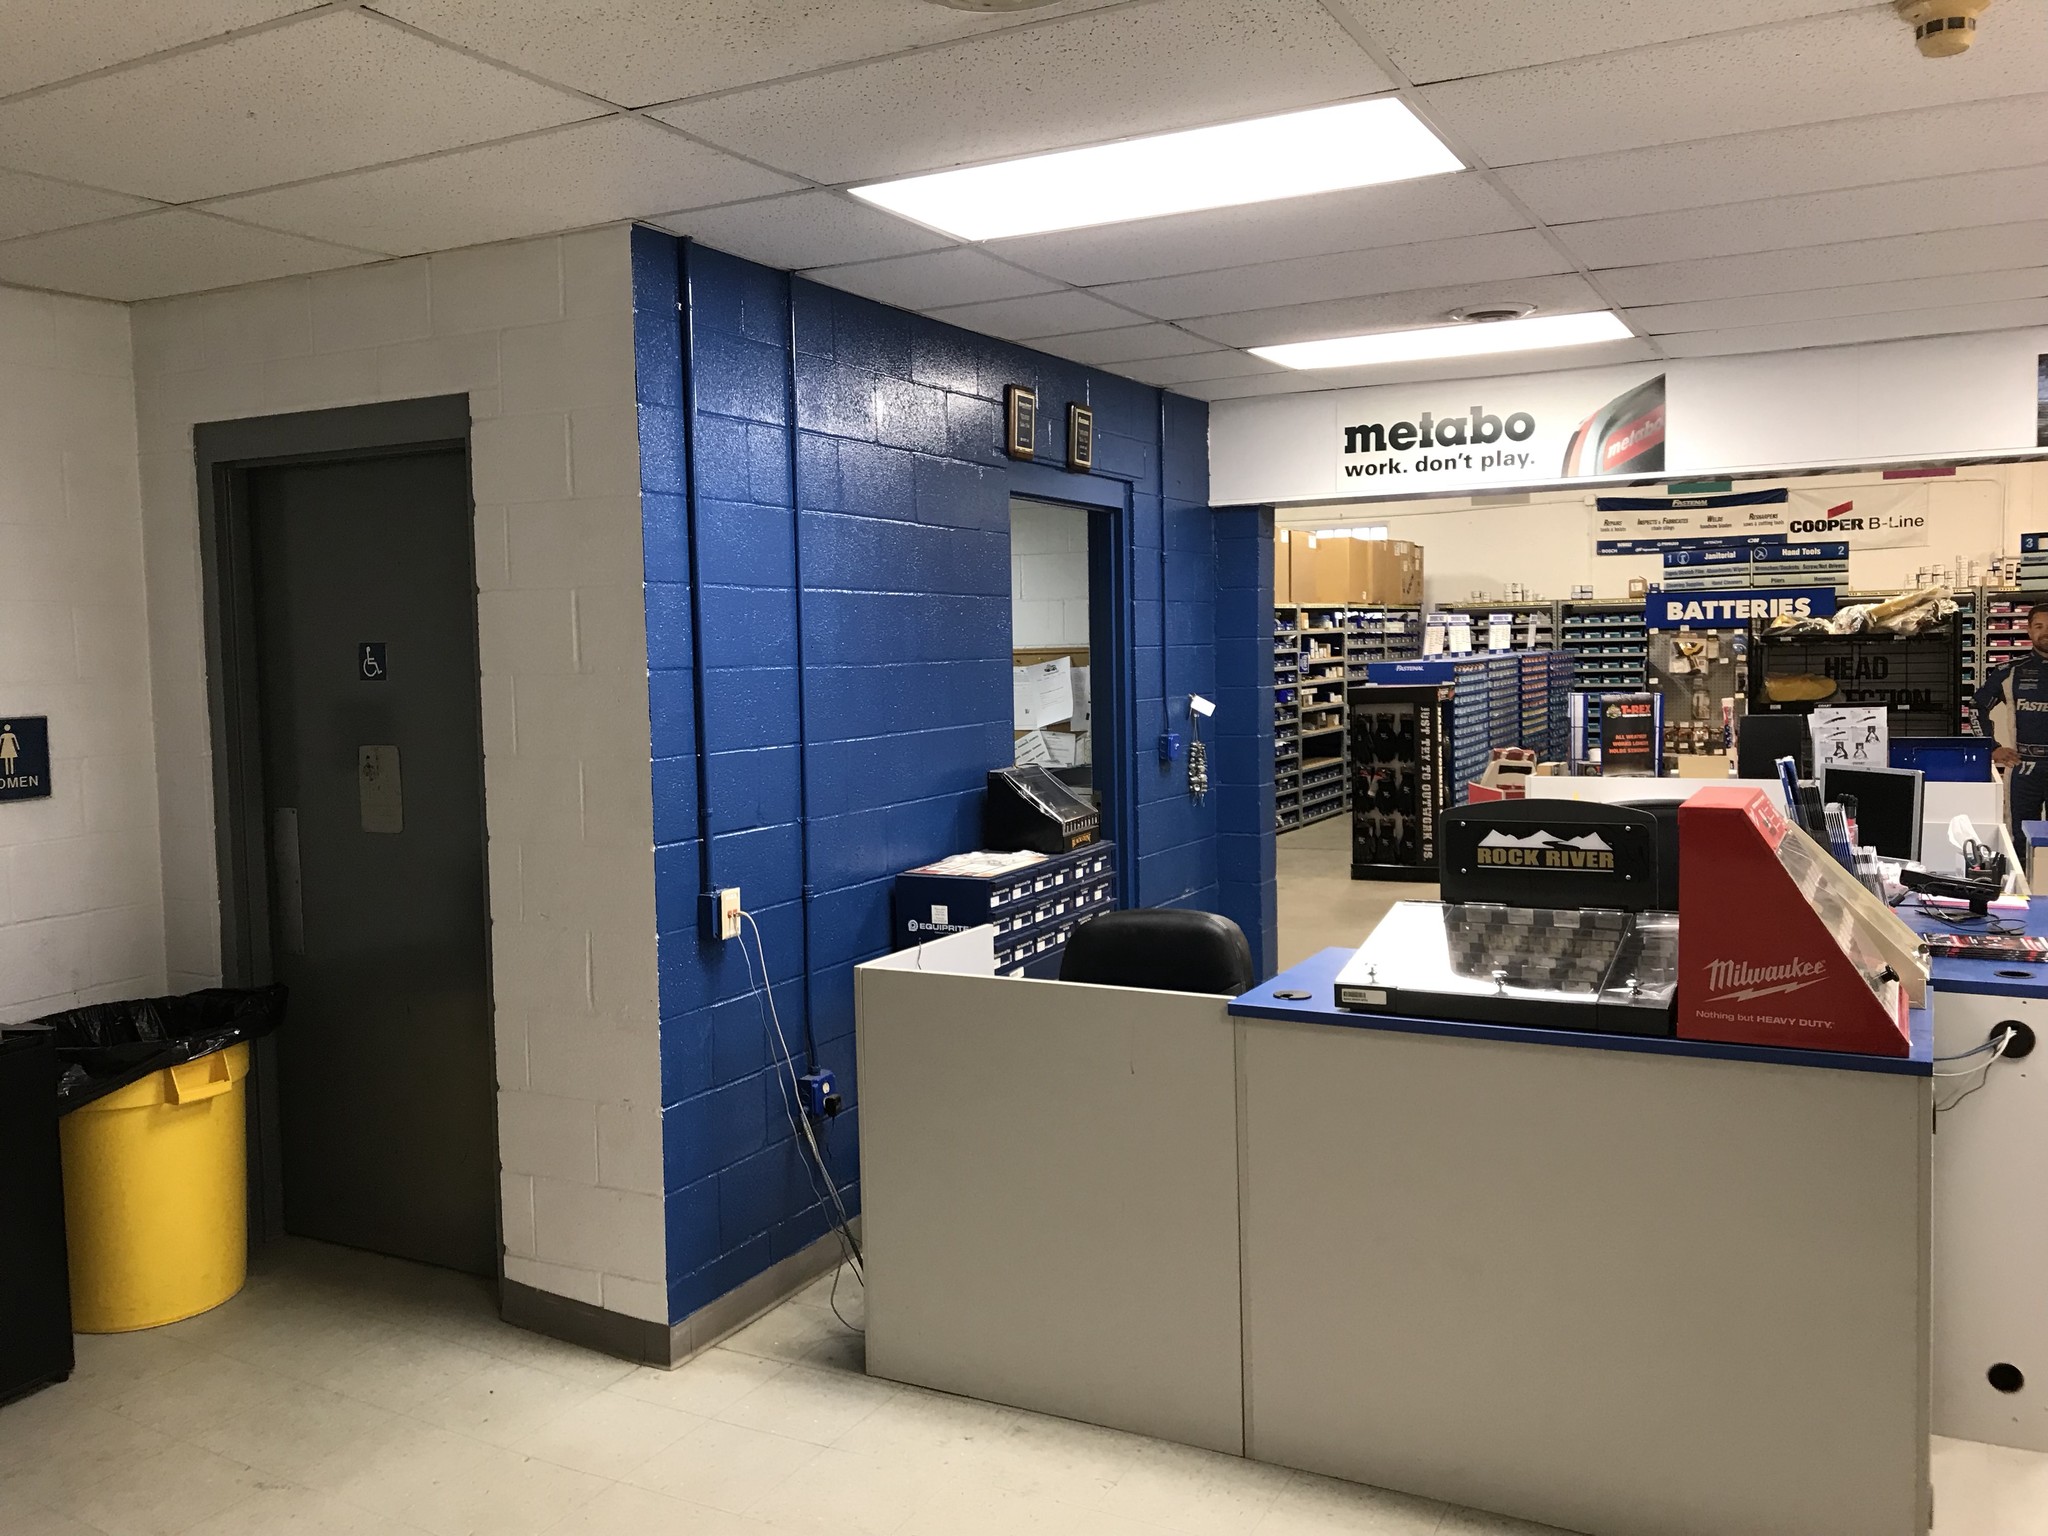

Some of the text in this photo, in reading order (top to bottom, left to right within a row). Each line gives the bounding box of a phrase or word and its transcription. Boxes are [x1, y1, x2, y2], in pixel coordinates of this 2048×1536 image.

[1345, 406, 1535, 453] metabo
[1345, 450, 1535, 477] work. don't play.
[1790, 515, 1924, 533] COOPER B-Line
[1782, 547, 1821, 556] Hand Tools
[1838, 545, 1845, 556] 2
[2026, 537, 2034, 548] 3
[1667, 554, 1673, 563] 1
[1704, 550, 1737, 560] Janitorial
[1667, 598, 1812, 621] BATTERIES
[1825, 656, 1888, 680] HEAD
[1620, 704, 1651, 714] T-REX
[1420, 706, 1431, 735] JUST
[1421, 738, 1431, 762] TRY
[1421, 764, 1432, 781] TO
[2018, 761, 2036, 776] 17
[1421, 783, 1433, 841] OUTWORK
[1477, 847, 1614, 868] ROCK RIVER
[919, 922, 969, 931] EQUIPRITE
[1702, 956, 1827, 992] Milwaukee
[1696, 1010, 1833, 1029] Nothing but HEAVY DUTY.
